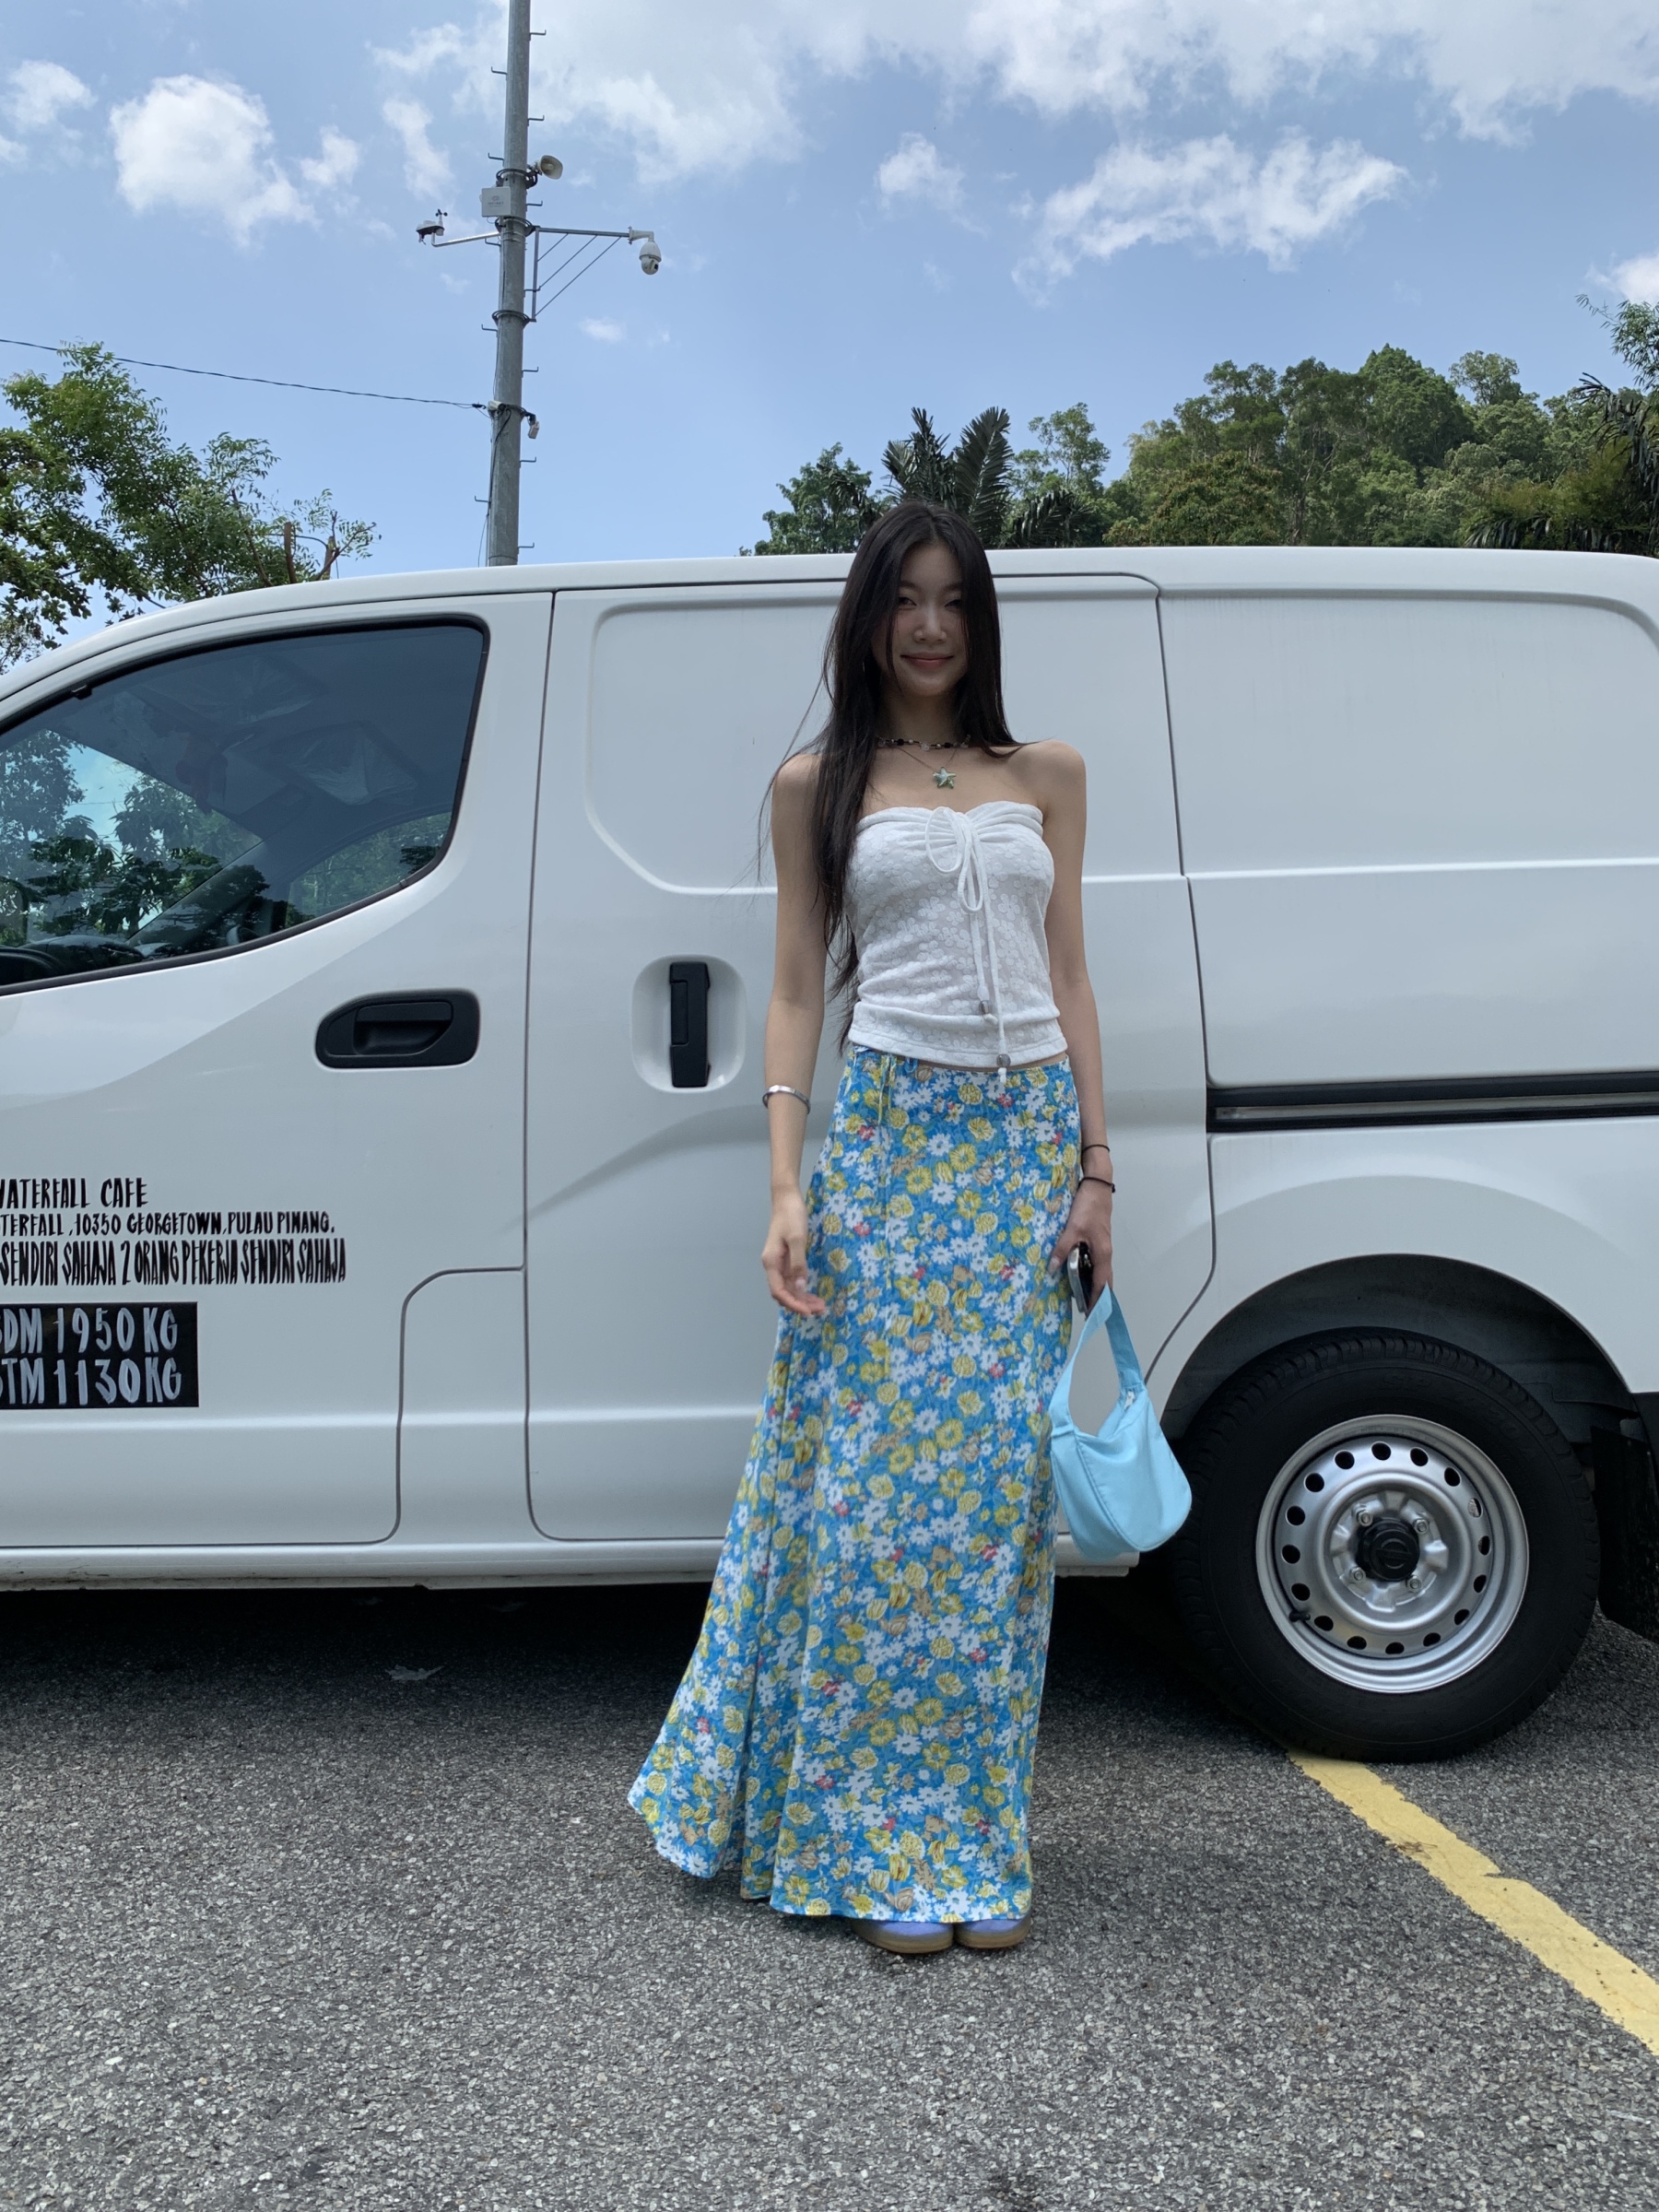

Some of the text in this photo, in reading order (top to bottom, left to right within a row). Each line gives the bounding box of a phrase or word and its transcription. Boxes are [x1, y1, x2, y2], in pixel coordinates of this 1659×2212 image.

[100, 1177, 148, 1208] CAFE
[0, 1237, 347, 1287] SENDIRI SAHAJA 2 ORANG PEKERJA SENDIRI SAHAJA
[0, 1307, 178, 1354] DM 1950 KG
[0, 1357, 182, 1406] TM 1130 KG
